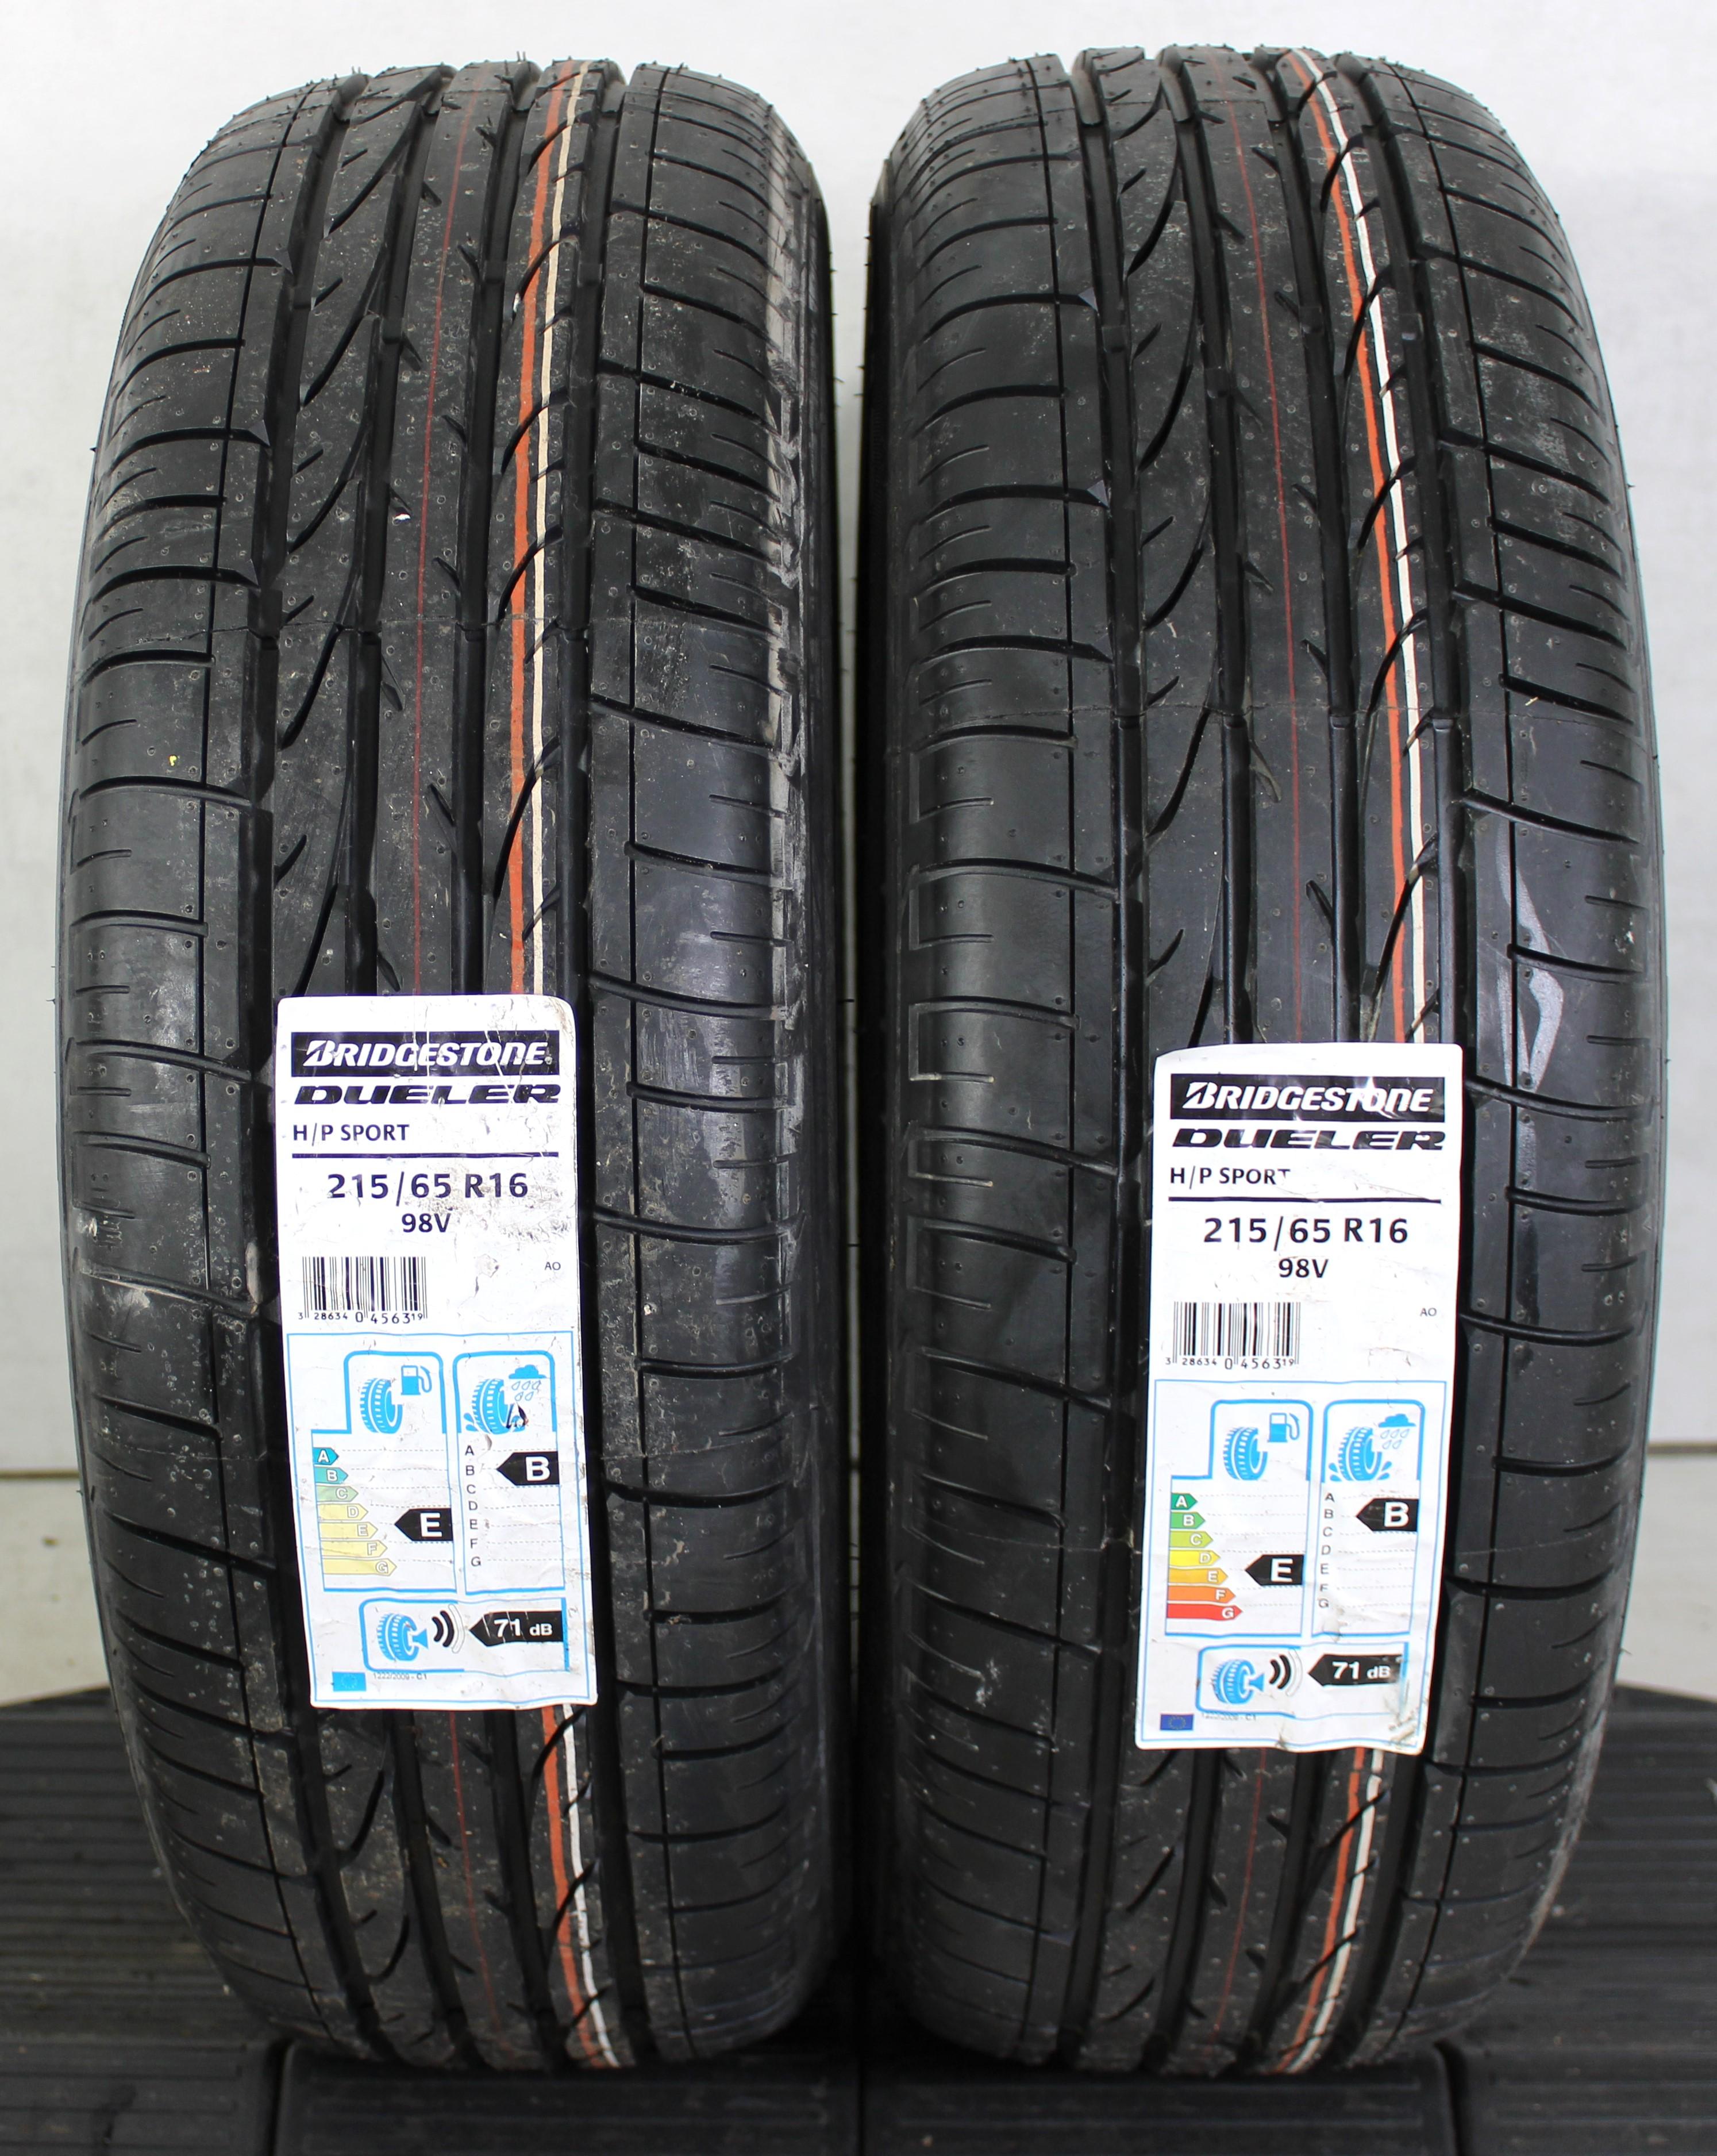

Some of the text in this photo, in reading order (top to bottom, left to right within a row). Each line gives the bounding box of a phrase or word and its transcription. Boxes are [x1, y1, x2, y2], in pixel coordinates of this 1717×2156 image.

[303, 1040, 549, 1067] BRIDGESTONE
[294, 1084, 561, 1105] DUELER
[1182, 1081, 1434, 1112] BRIDGESTONE
[292, 1123, 410, 1147] H/P SPORT
[1172, 1128, 1446, 1150] DUELER
[1170, 1165, 1291, 1189] H/P SPORT
[327, 1171, 529, 1206] 215/65 R16
[402, 1213, 452, 1233] 98V
[1204, 1216, 1408, 1251] 215/65 R16
[1278, 1258, 1329, 1278] 98V
[318, 1450, 329, 1463] A
[464, 1445, 475, 1456] A
[465, 1465, 475, 1476] B
[525, 1455, 551, 1482] B
[326, 1470, 338, 1482] B
[336, 1487, 348, 1500] C
[467, 1484, 476, 1494] C
[1175, 1495, 1188, 1508] A
[1325, 1492, 1335, 1502] A
[347, 1505, 359, 1519] D
[468, 1501, 478, 1511] D
[1324, 1509, 1334, 1519] B
[1383, 1501, 1410, 1528] B
[419, 1512, 442, 1537] E
[469, 1519, 478, 1529] E
[1183, 1515, 1195, 1527] B
[356, 1524, 369, 1537] E
[1323, 1527, 1333, 1537] C
[470, 1539, 478, 1549] F
[1190, 1534, 1202, 1546] C
[367, 1543, 378, 1555] F
[1321, 1545, 1331, 1555] D
[471, 1557, 482, 1567] G
[1199, 1552, 1212, 1564] D
[375, 1561, 389, 1574] G
[1270, 1557, 1294, 1584] E
[1320, 1563, 1330, 1575] E
[1207, 1571, 1218, 1583] E
[1319, 1583, 1329, 1593] F
[1215, 1589, 1226, 1601] F
[1318, 1598, 1329, 1609] G
[1222, 1607, 1235, 1619] G
[493, 1619, 553, 1638] 71 dB
[1331, 1661, 1391, 1680] 71 dB
